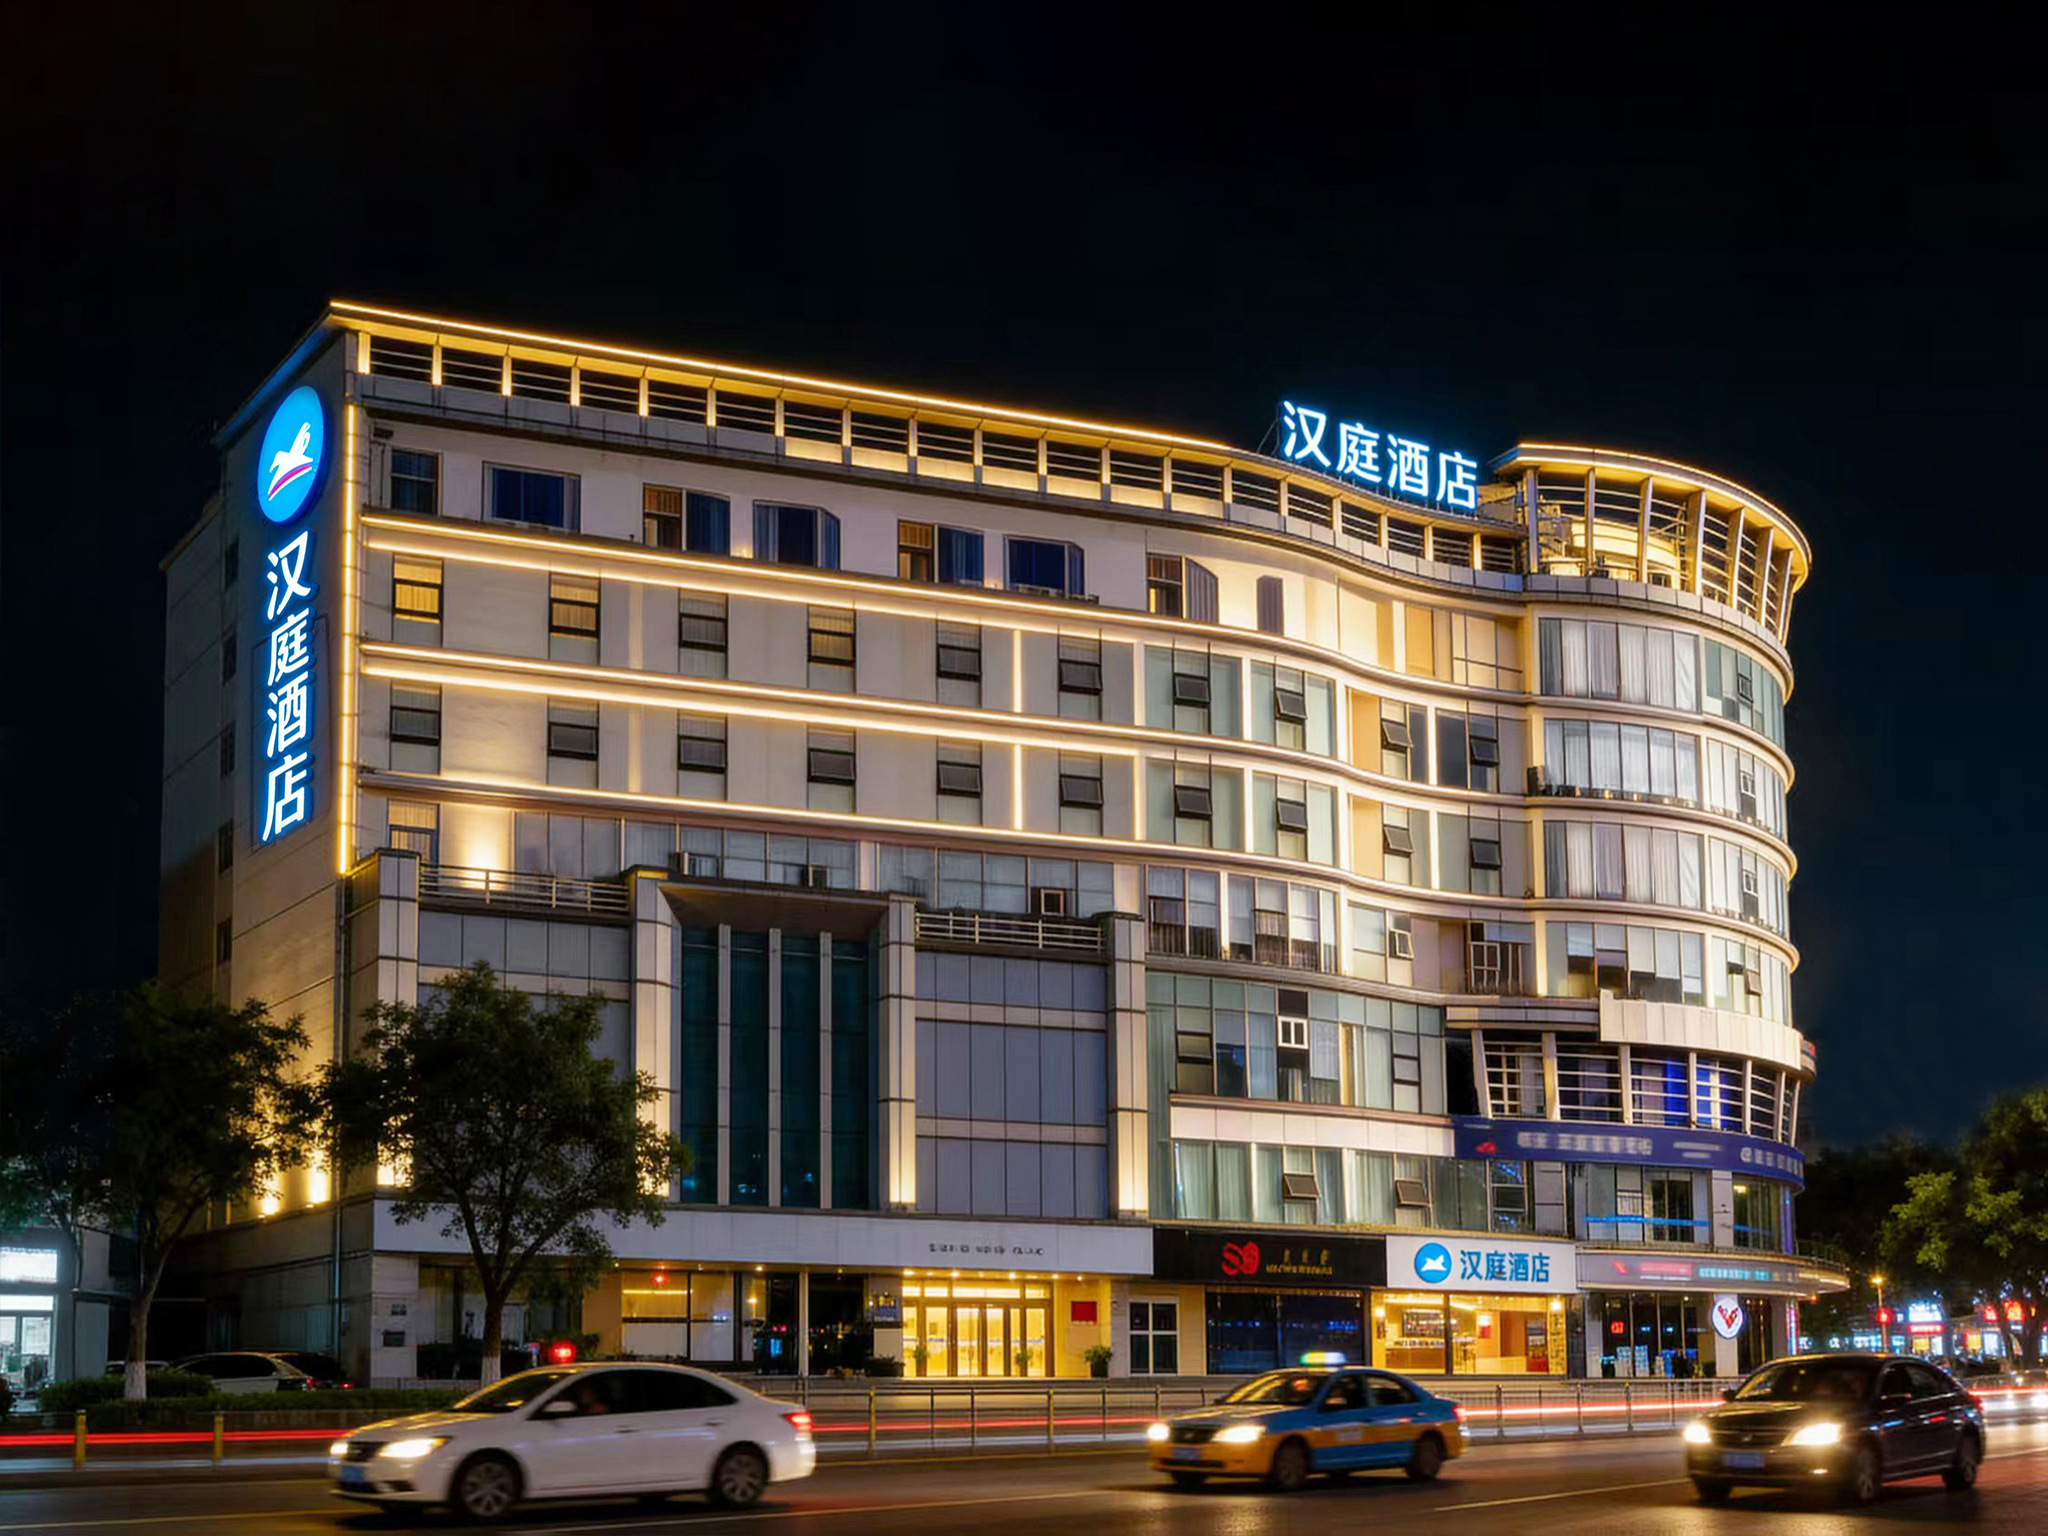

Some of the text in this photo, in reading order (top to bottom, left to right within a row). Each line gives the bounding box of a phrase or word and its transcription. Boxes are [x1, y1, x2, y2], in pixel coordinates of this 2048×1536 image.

[1283, 400, 1478, 510] 汉庭酒店
[262, 531, 312, 842] 汉庭酒店
[1460, 1249, 1551, 1283] 汉庭酒店
